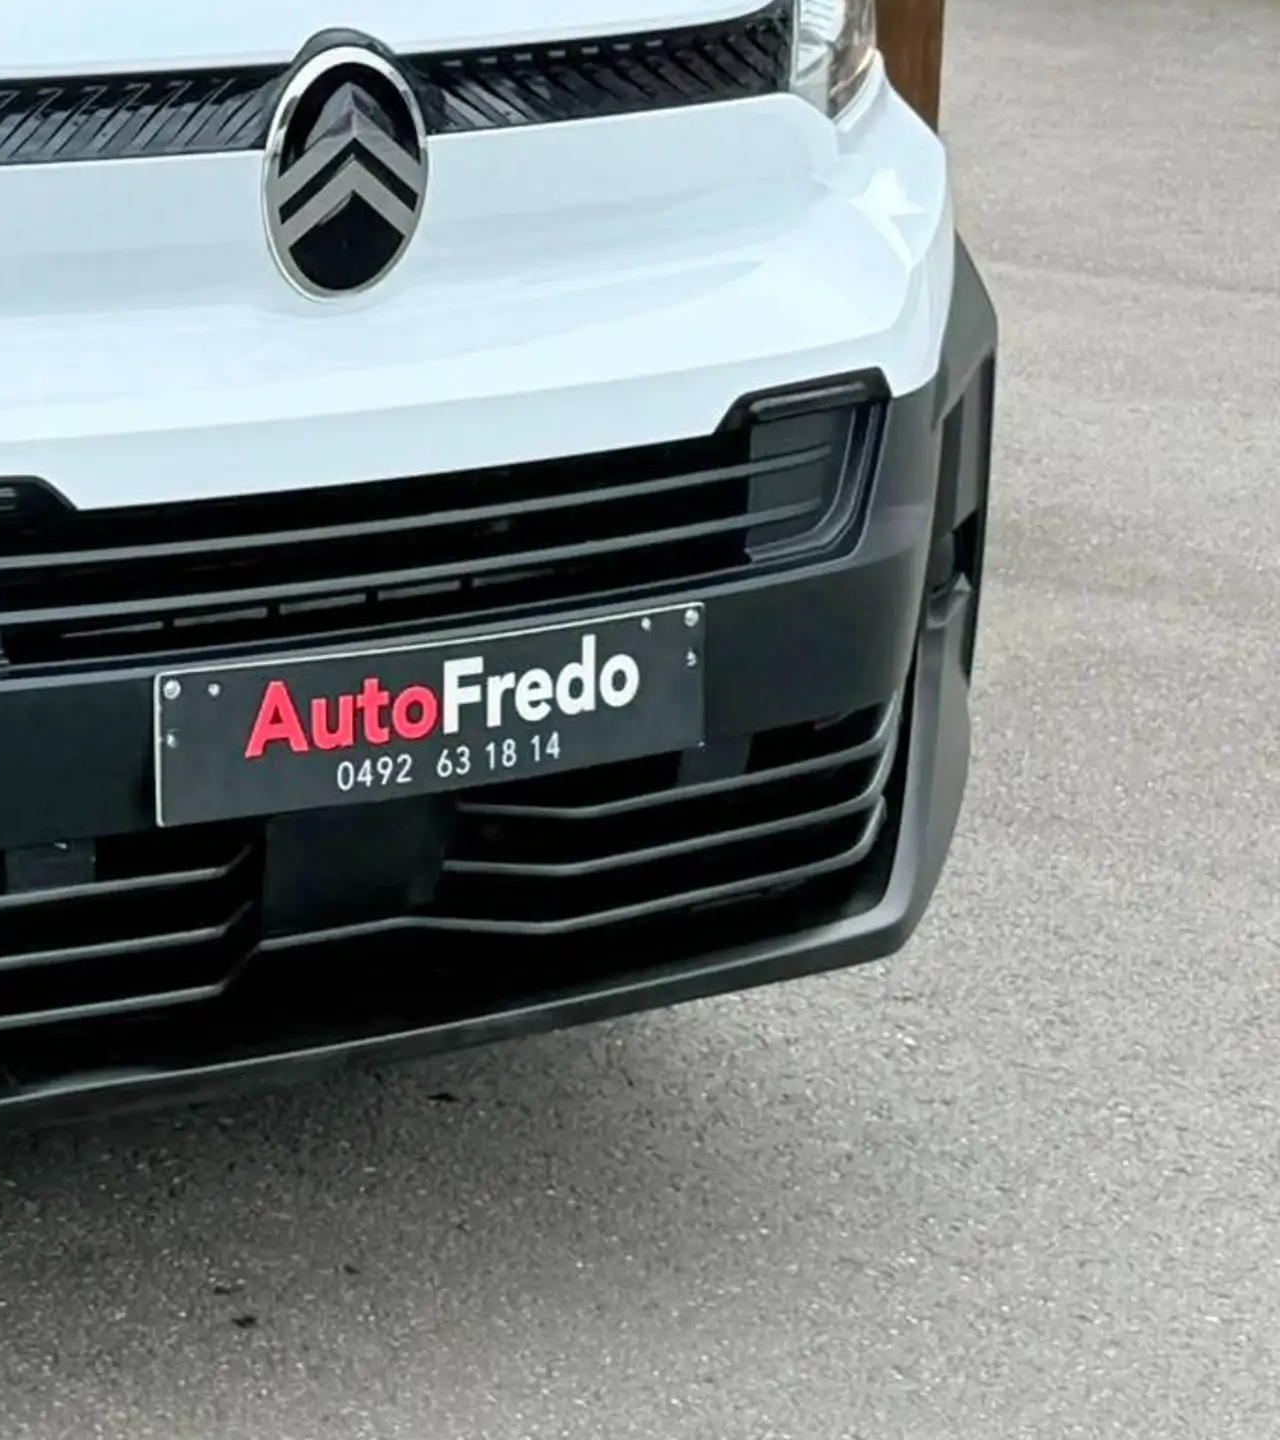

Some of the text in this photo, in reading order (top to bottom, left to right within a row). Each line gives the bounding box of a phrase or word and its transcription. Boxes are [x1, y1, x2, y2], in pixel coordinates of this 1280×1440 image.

[244, 634, 639, 758] AutoFredo
[337, 731, 561, 791] 0492 63 18 14
